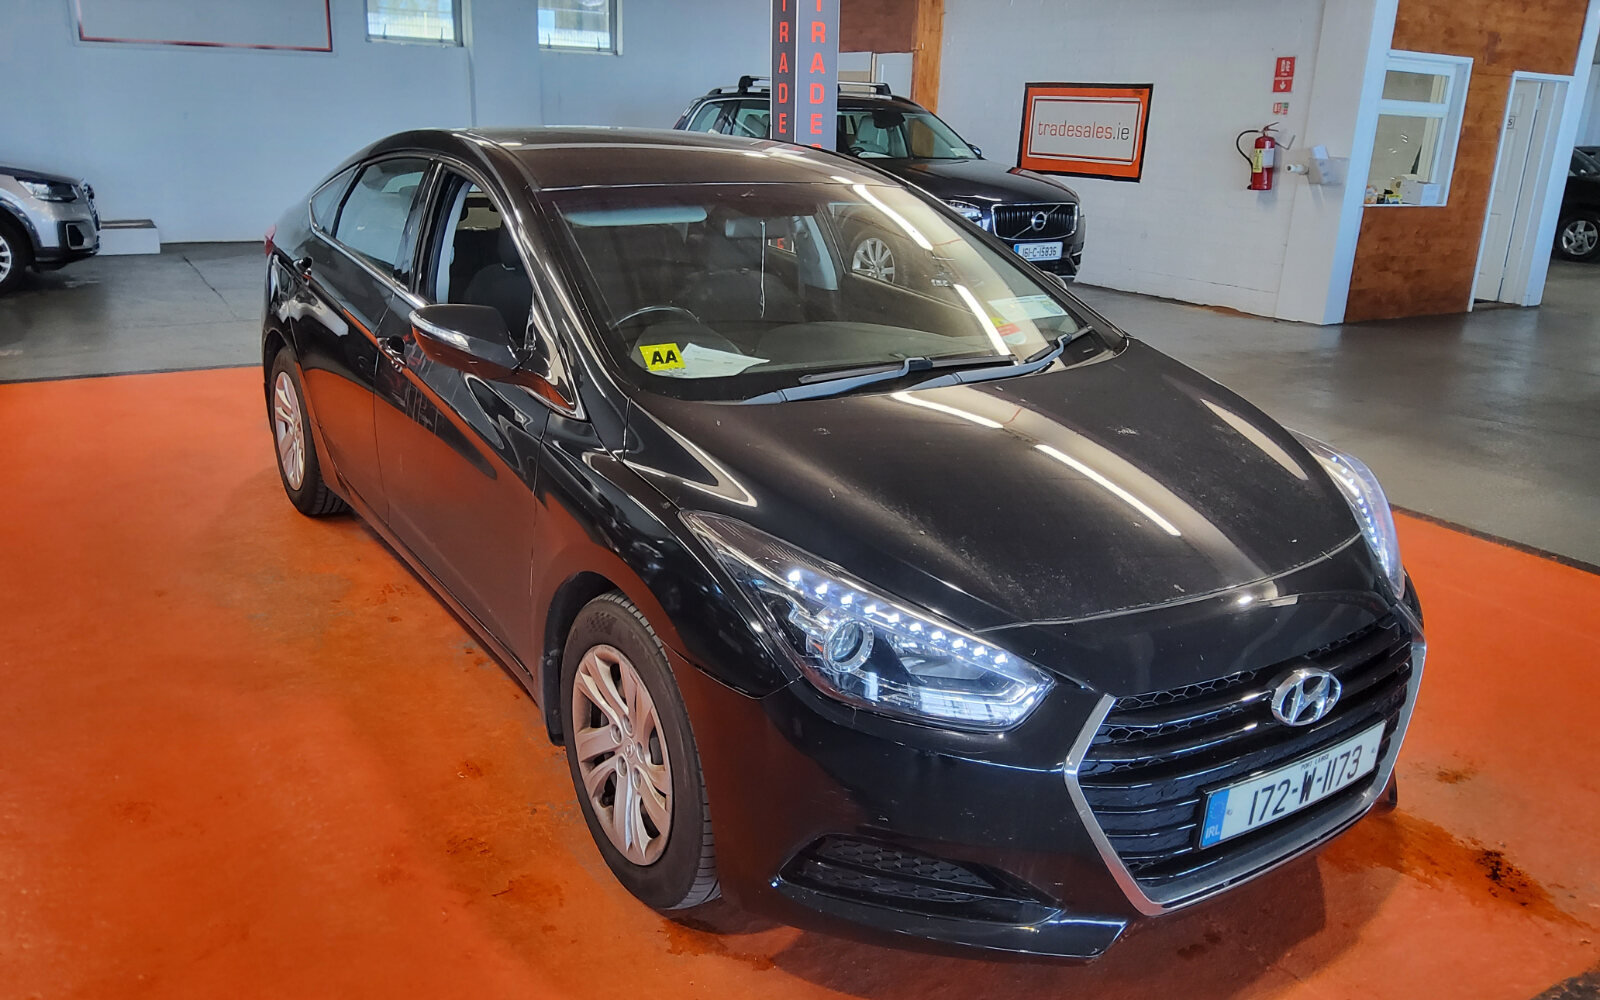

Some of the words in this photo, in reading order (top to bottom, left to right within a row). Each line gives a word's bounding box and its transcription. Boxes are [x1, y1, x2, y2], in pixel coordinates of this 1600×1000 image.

[1038, 120, 1130, 141] tradesales.ie
[651, 349, 678, 365] AA
[1247, 745, 1363, 826] 172-W-1173
[1205, 825, 1221, 840] IRL
